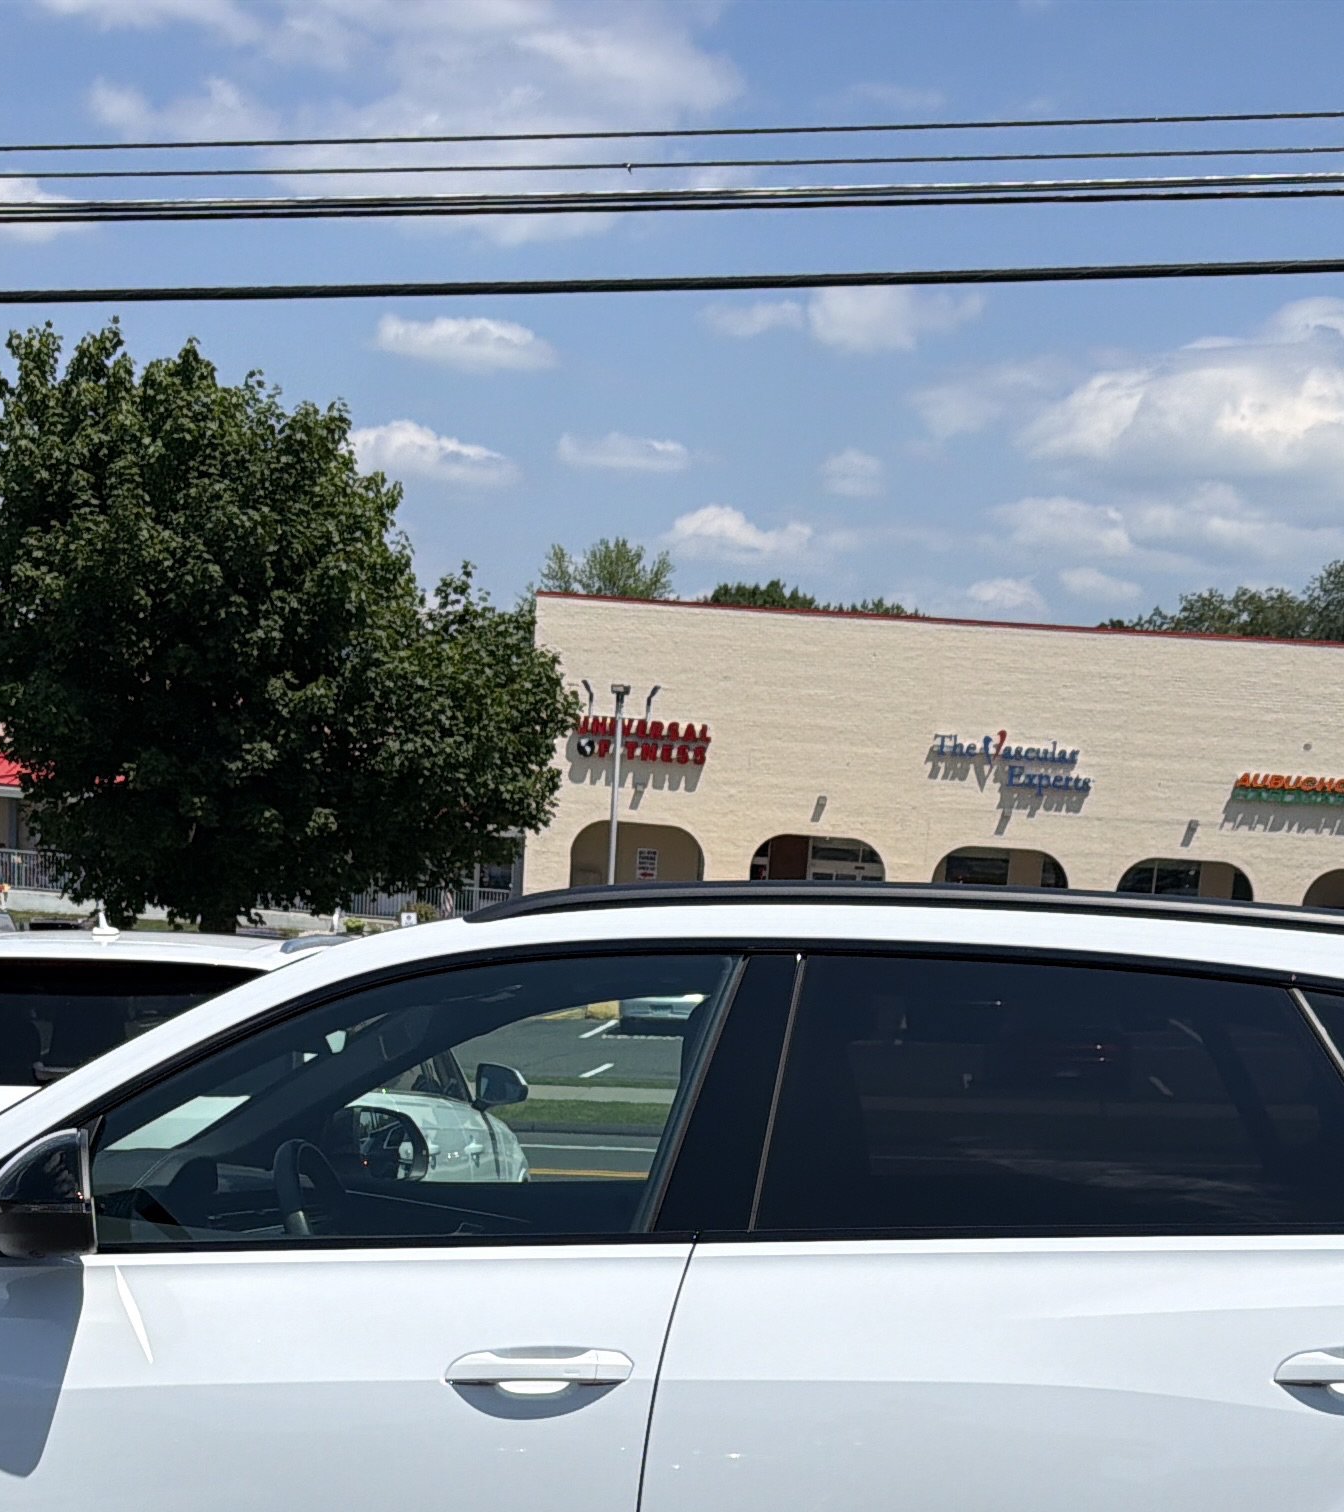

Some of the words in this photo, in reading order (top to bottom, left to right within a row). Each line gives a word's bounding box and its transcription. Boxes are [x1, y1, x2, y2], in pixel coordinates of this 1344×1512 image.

[577, 716, 711, 743] UNIVERSAL
[598, 739, 706, 764] FTNESS
[934, 734, 977, 756] The
[982, 729, 1080, 768] Vascular
[1008, 765, 1091, 796] Experts
